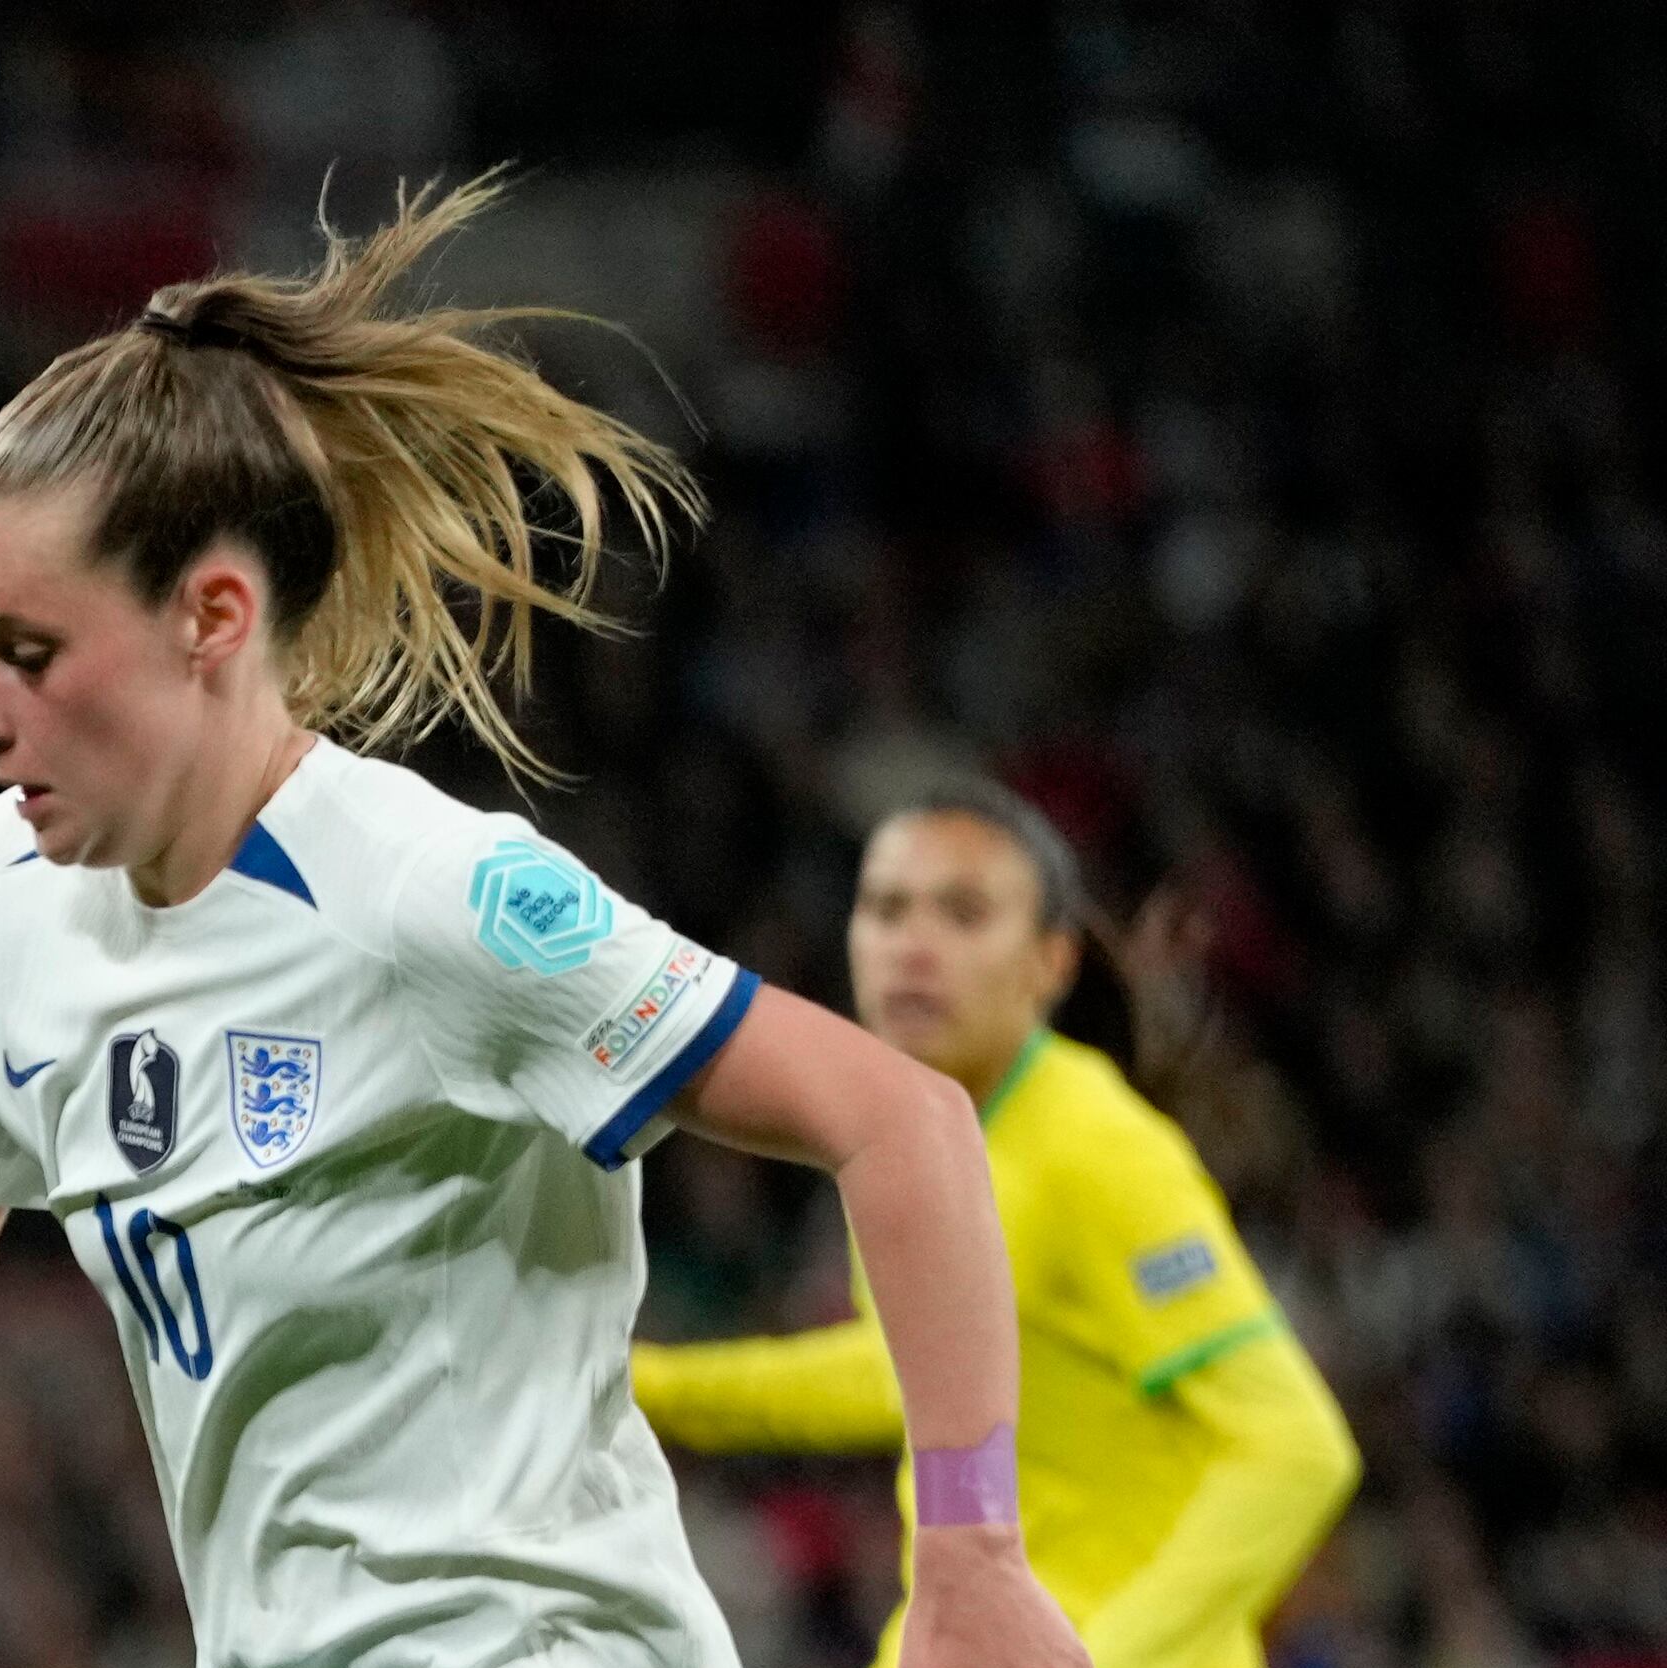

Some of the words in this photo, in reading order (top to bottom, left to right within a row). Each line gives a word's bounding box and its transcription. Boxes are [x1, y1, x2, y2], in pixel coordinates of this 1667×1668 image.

[533, 890, 580, 934] Strong
[593, 944, 698, 1067] FOUNDATIO
[117, 1131, 166, 1153] CHAMPIONS
[118, 1119, 164, 1139] EUROPEAN
[94, 1191, 214, 1382] 10
